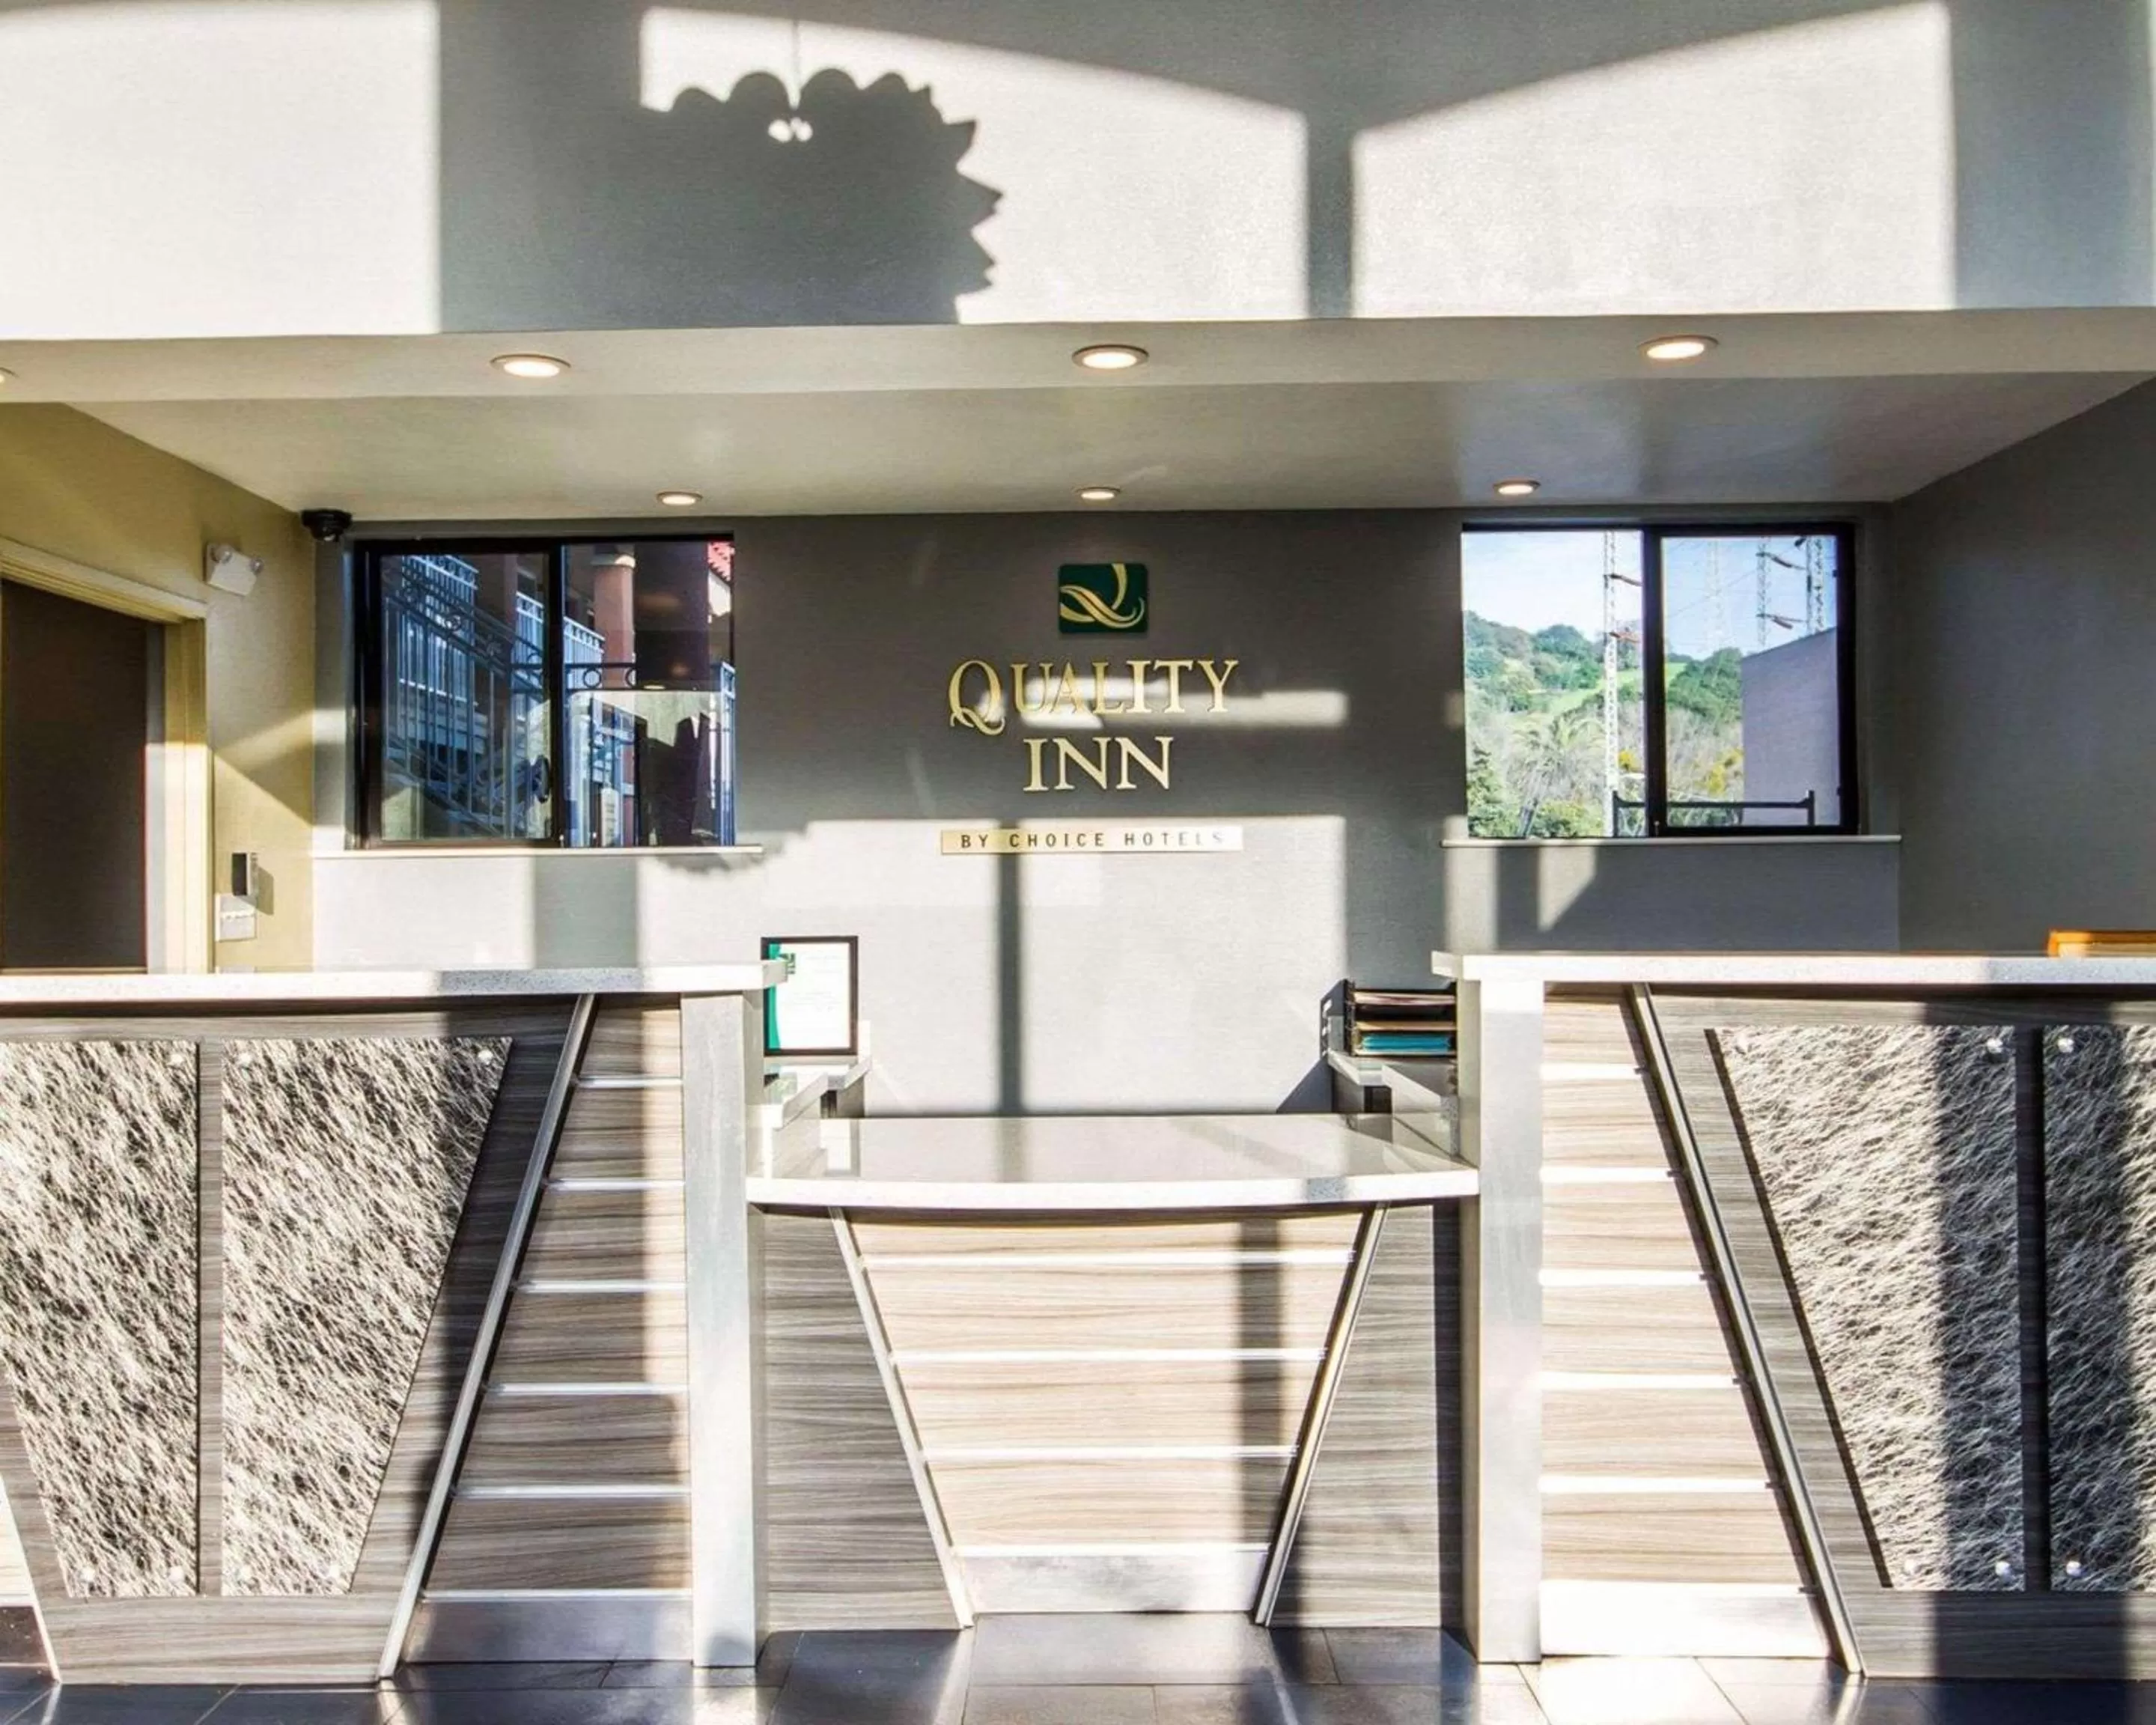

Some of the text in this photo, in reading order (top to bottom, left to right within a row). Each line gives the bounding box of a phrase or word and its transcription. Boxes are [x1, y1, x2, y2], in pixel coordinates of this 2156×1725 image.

[948, 658, 1240, 736] QUALITY
[1023, 736, 1175, 792] INN
[960, 831, 1224, 848] BY CHOICE HOTELS
